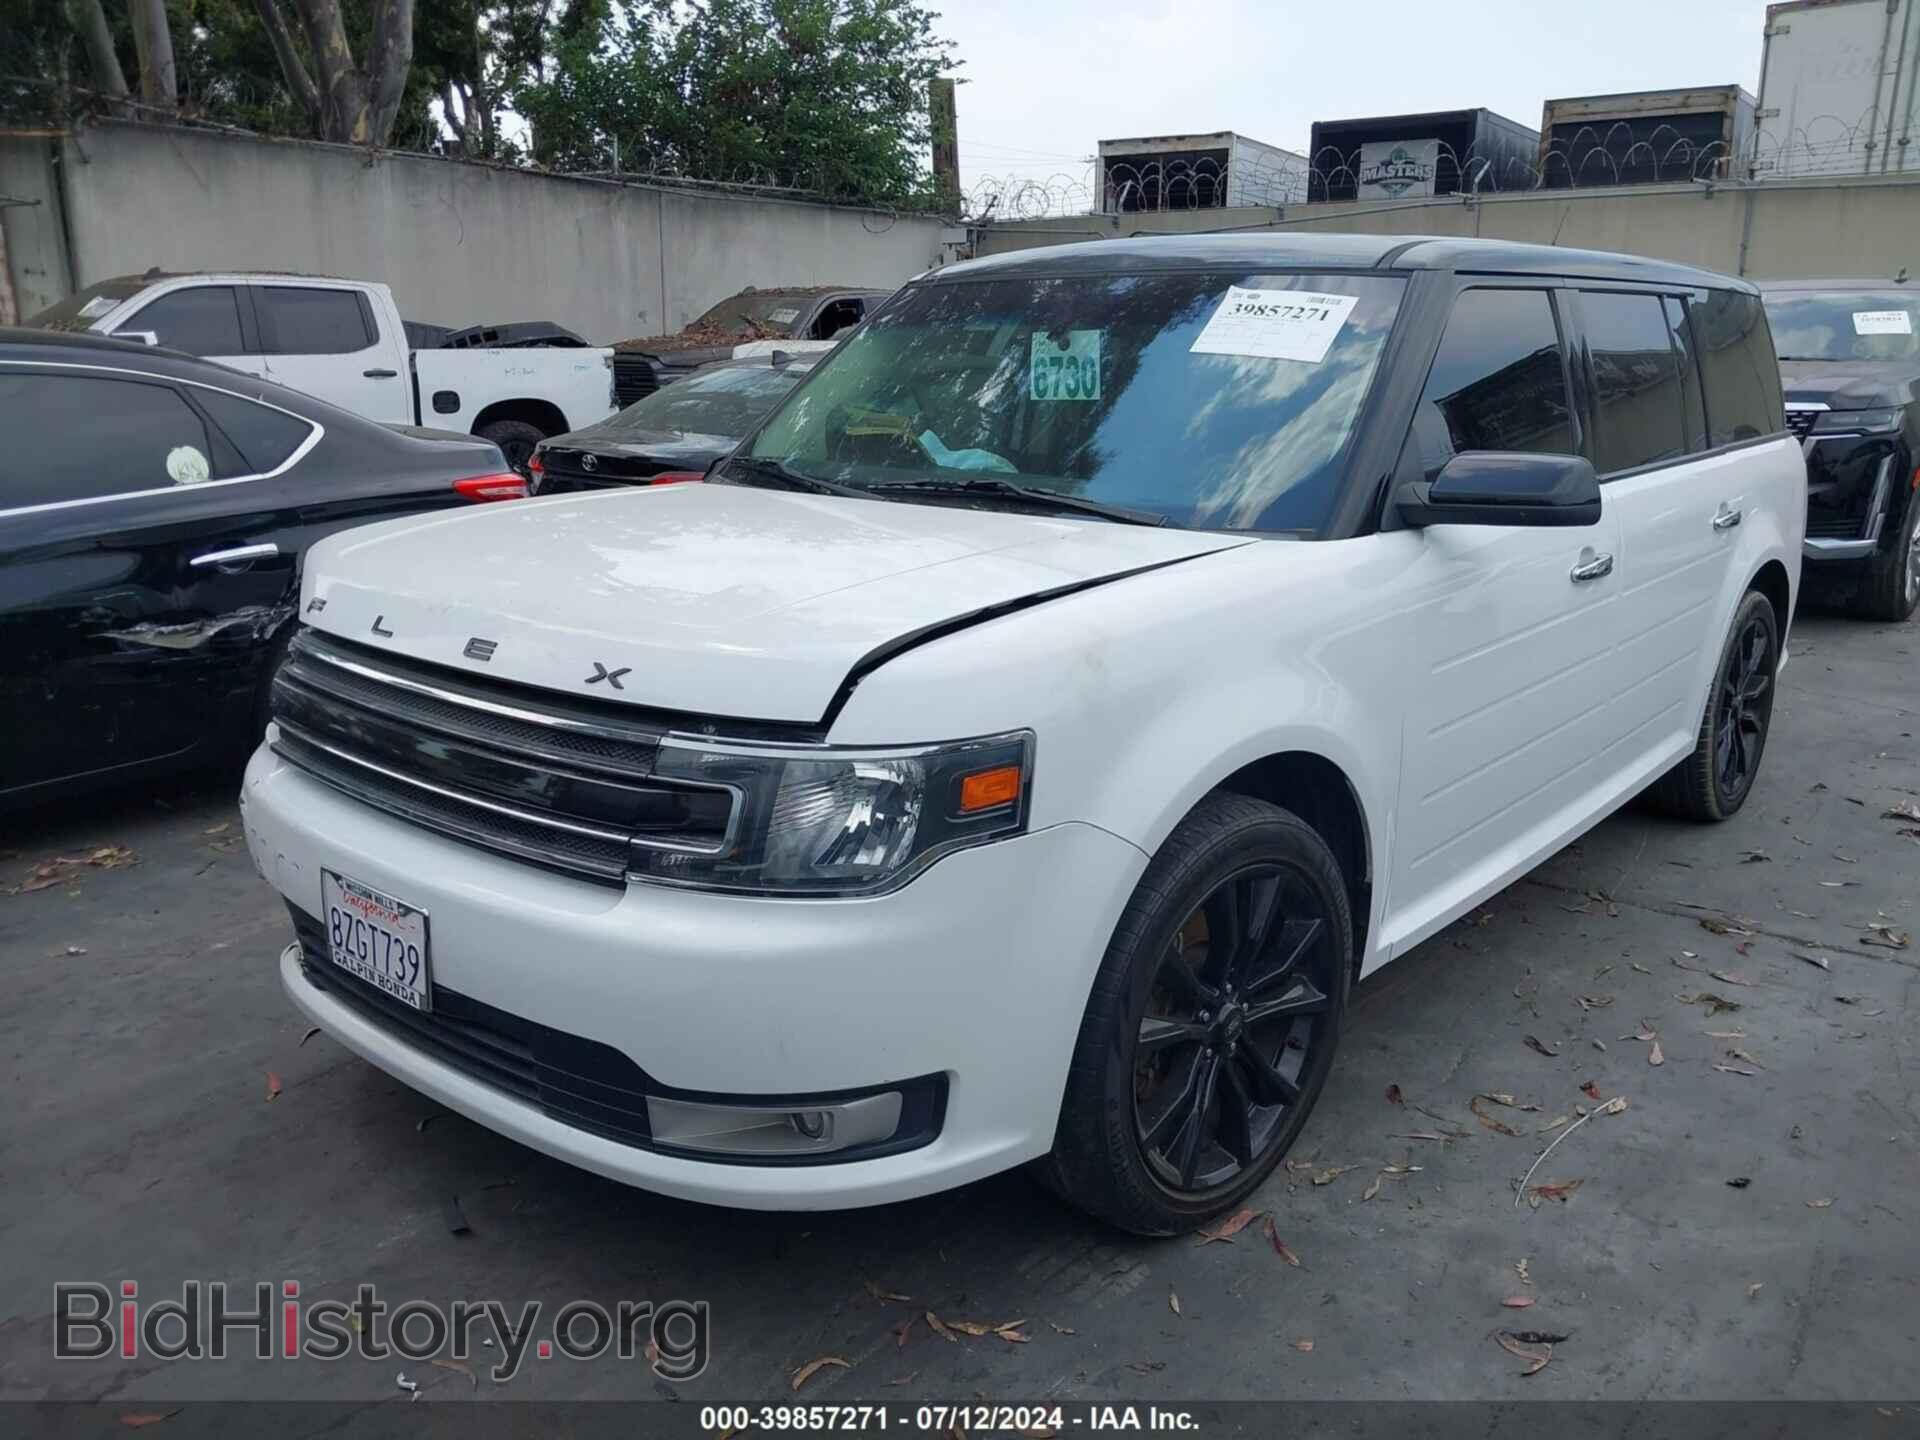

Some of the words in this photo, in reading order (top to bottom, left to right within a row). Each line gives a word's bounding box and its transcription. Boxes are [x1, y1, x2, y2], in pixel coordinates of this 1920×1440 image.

[1361, 163, 1434, 182] MASTERS
[1228, 302, 1330, 322] 39857271
[1034, 355, 1097, 399] 6730
[331, 906, 420, 987] 8ZGT739
[334, 951, 376, 982] GALPIN
[378, 974, 417, 1007] HONDA
